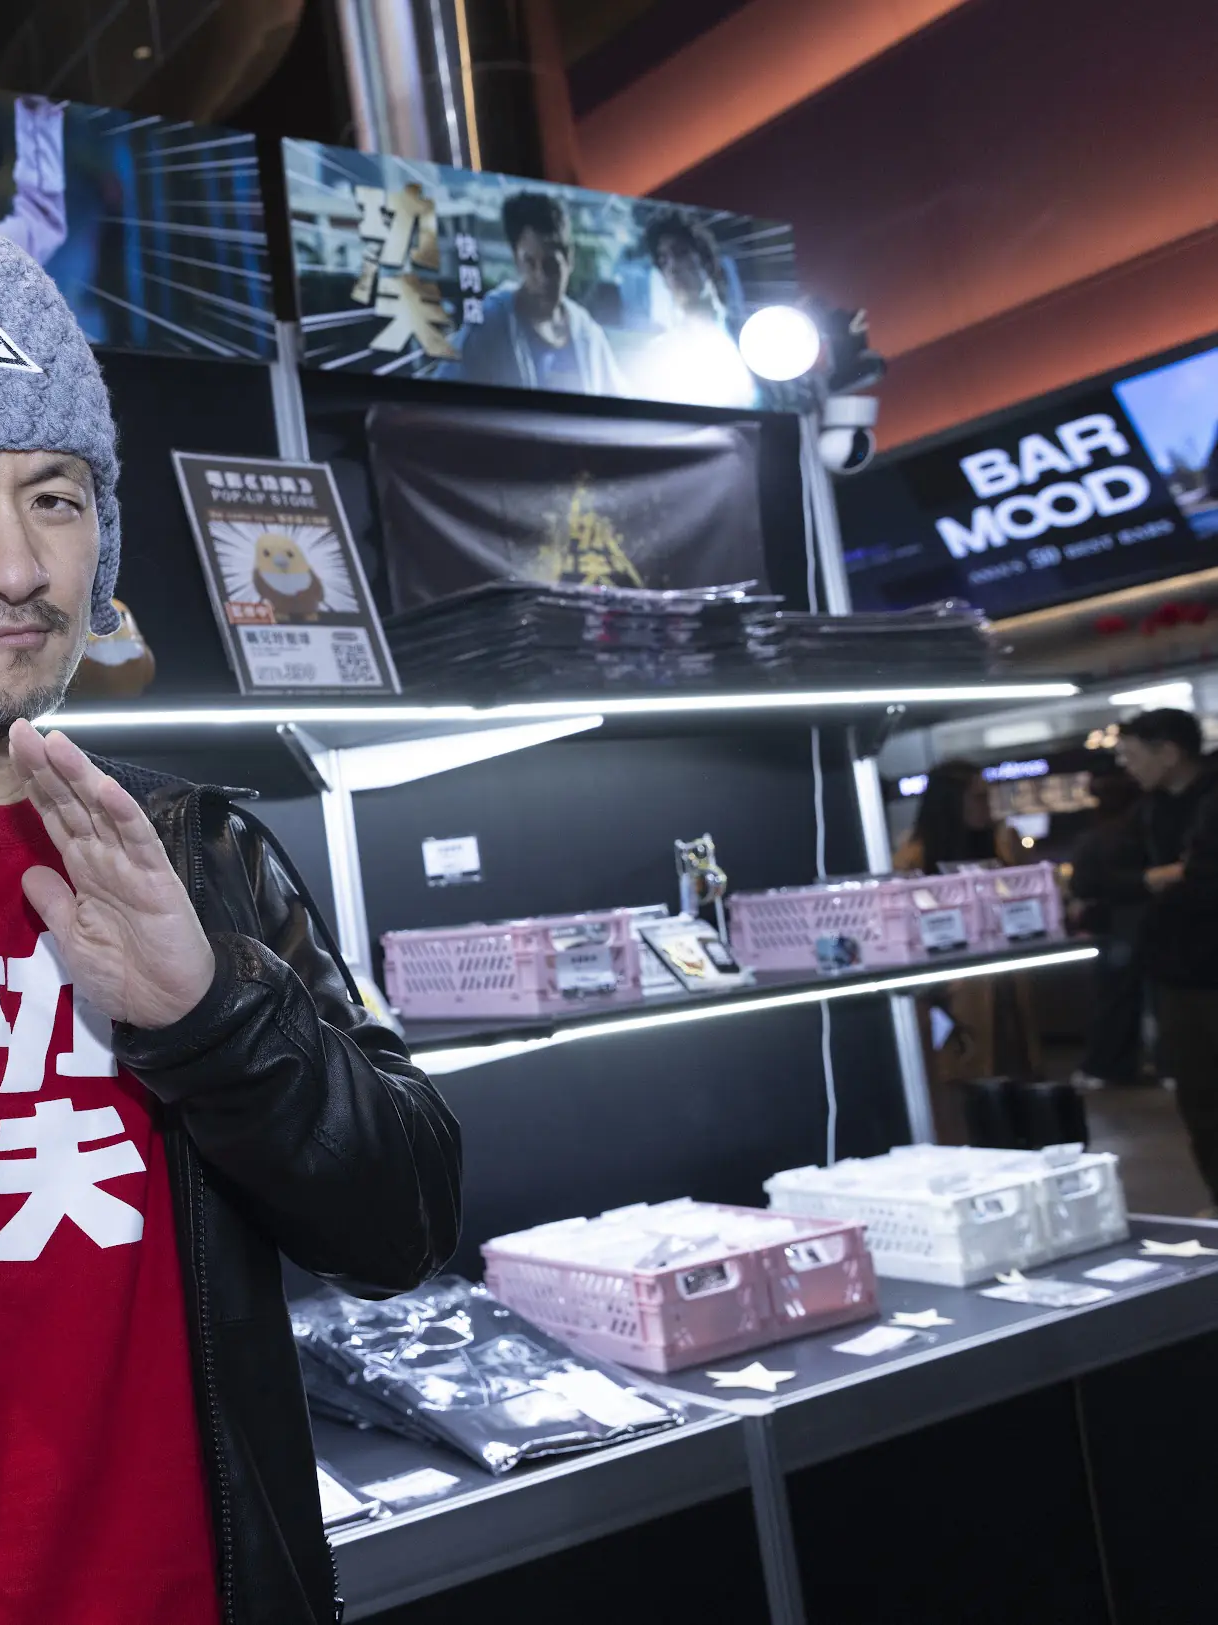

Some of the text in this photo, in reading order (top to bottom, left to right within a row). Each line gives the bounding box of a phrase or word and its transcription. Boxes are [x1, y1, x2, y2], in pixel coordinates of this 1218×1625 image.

[355, 183, 462, 359] 功夫
[959, 413, 1130, 499] BAR
[935, 465, 1151, 559] MOOD
